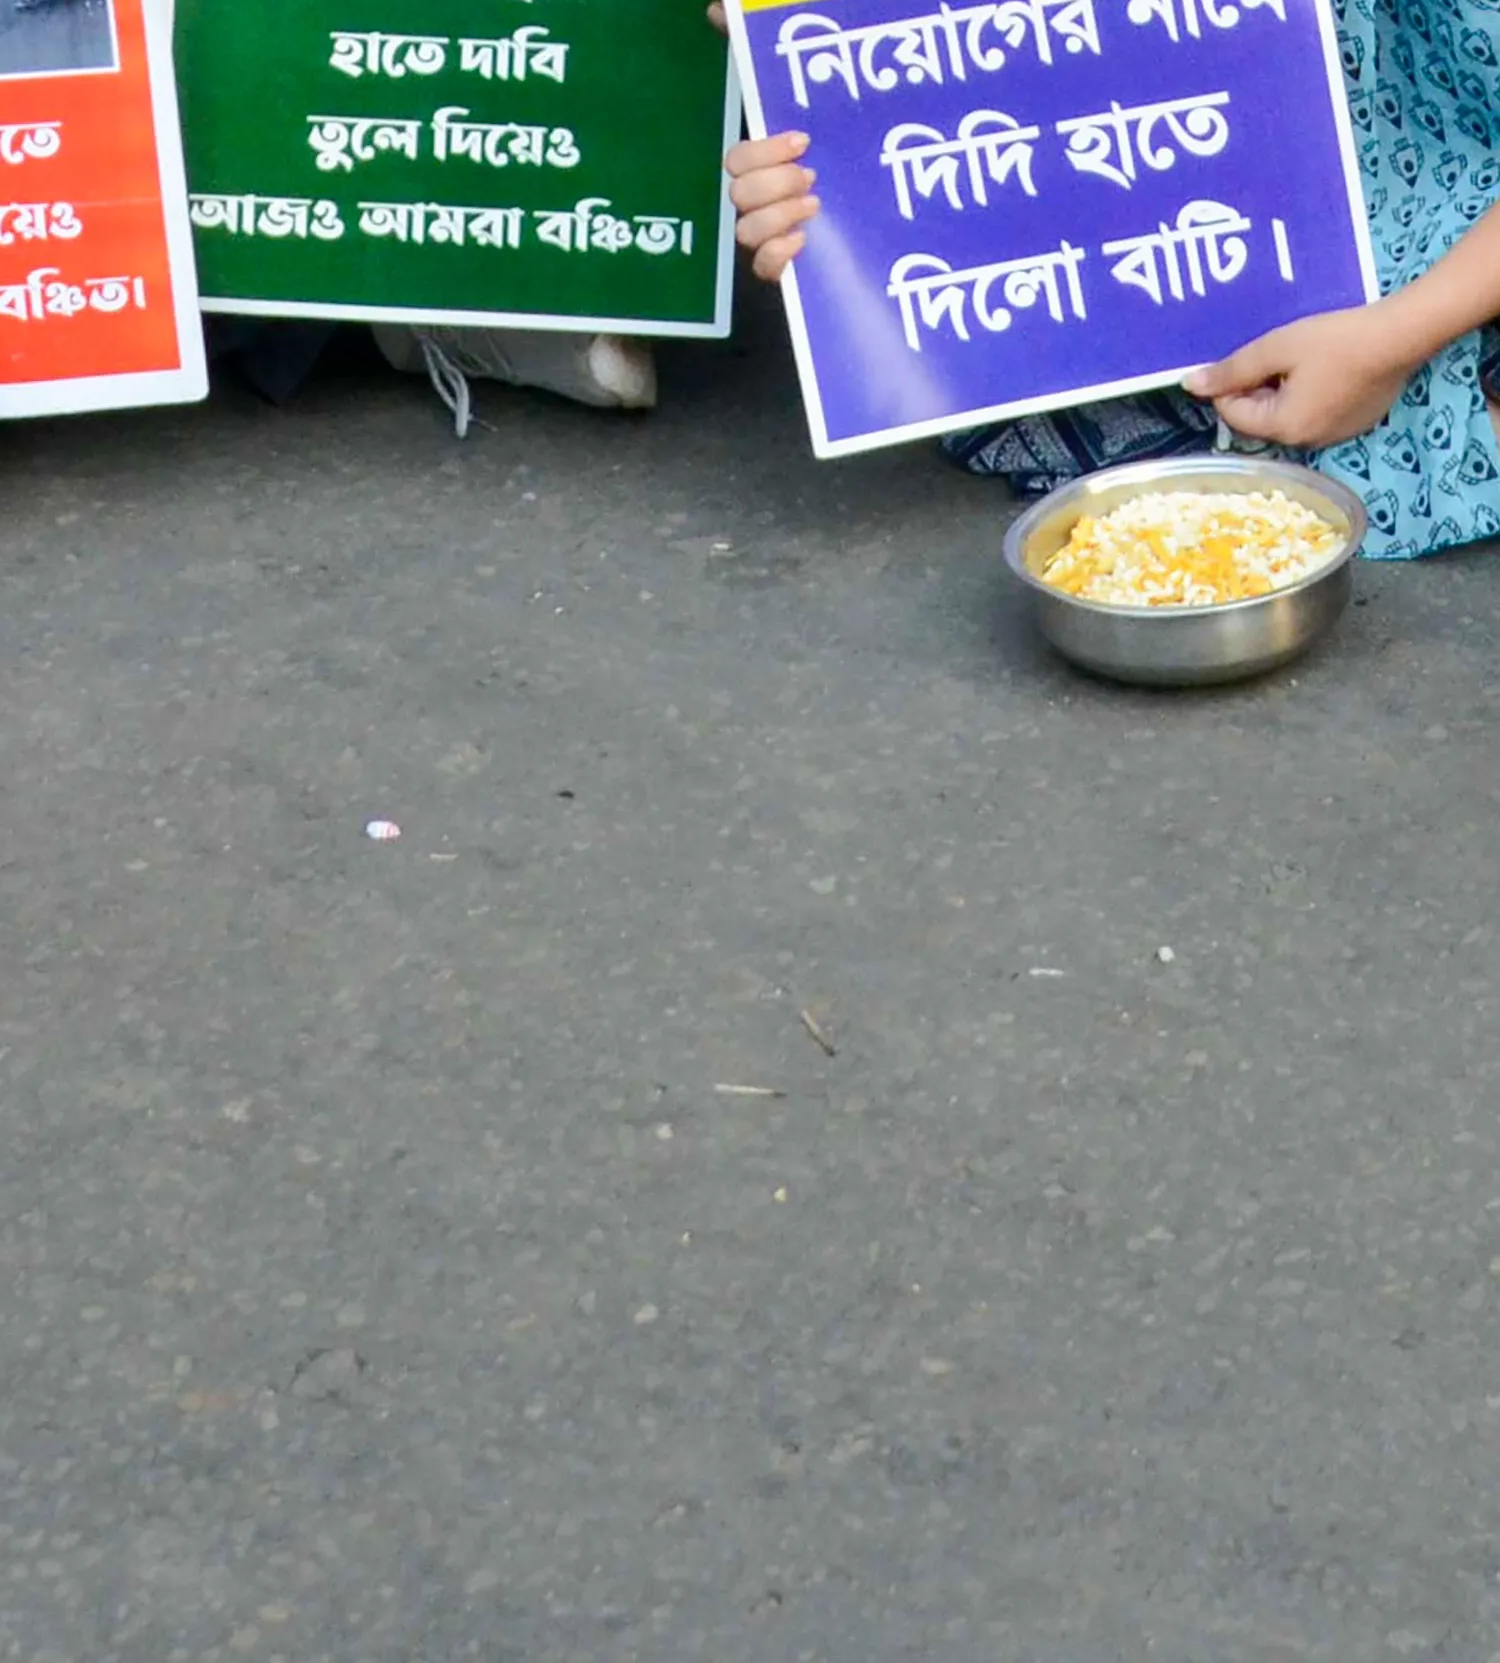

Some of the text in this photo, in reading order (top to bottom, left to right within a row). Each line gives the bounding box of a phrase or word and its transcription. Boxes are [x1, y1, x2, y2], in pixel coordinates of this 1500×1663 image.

[330, 26, 569, 82] হাতে দাবি
[307, 107, 580, 171] তুলে দিয়েও
[880, 92, 1229, 219] দিদি হাতে
[189, 193, 692, 254] আজও আমরা বঞ্চিত।
[887, 240, 1086, 352] দিলো
